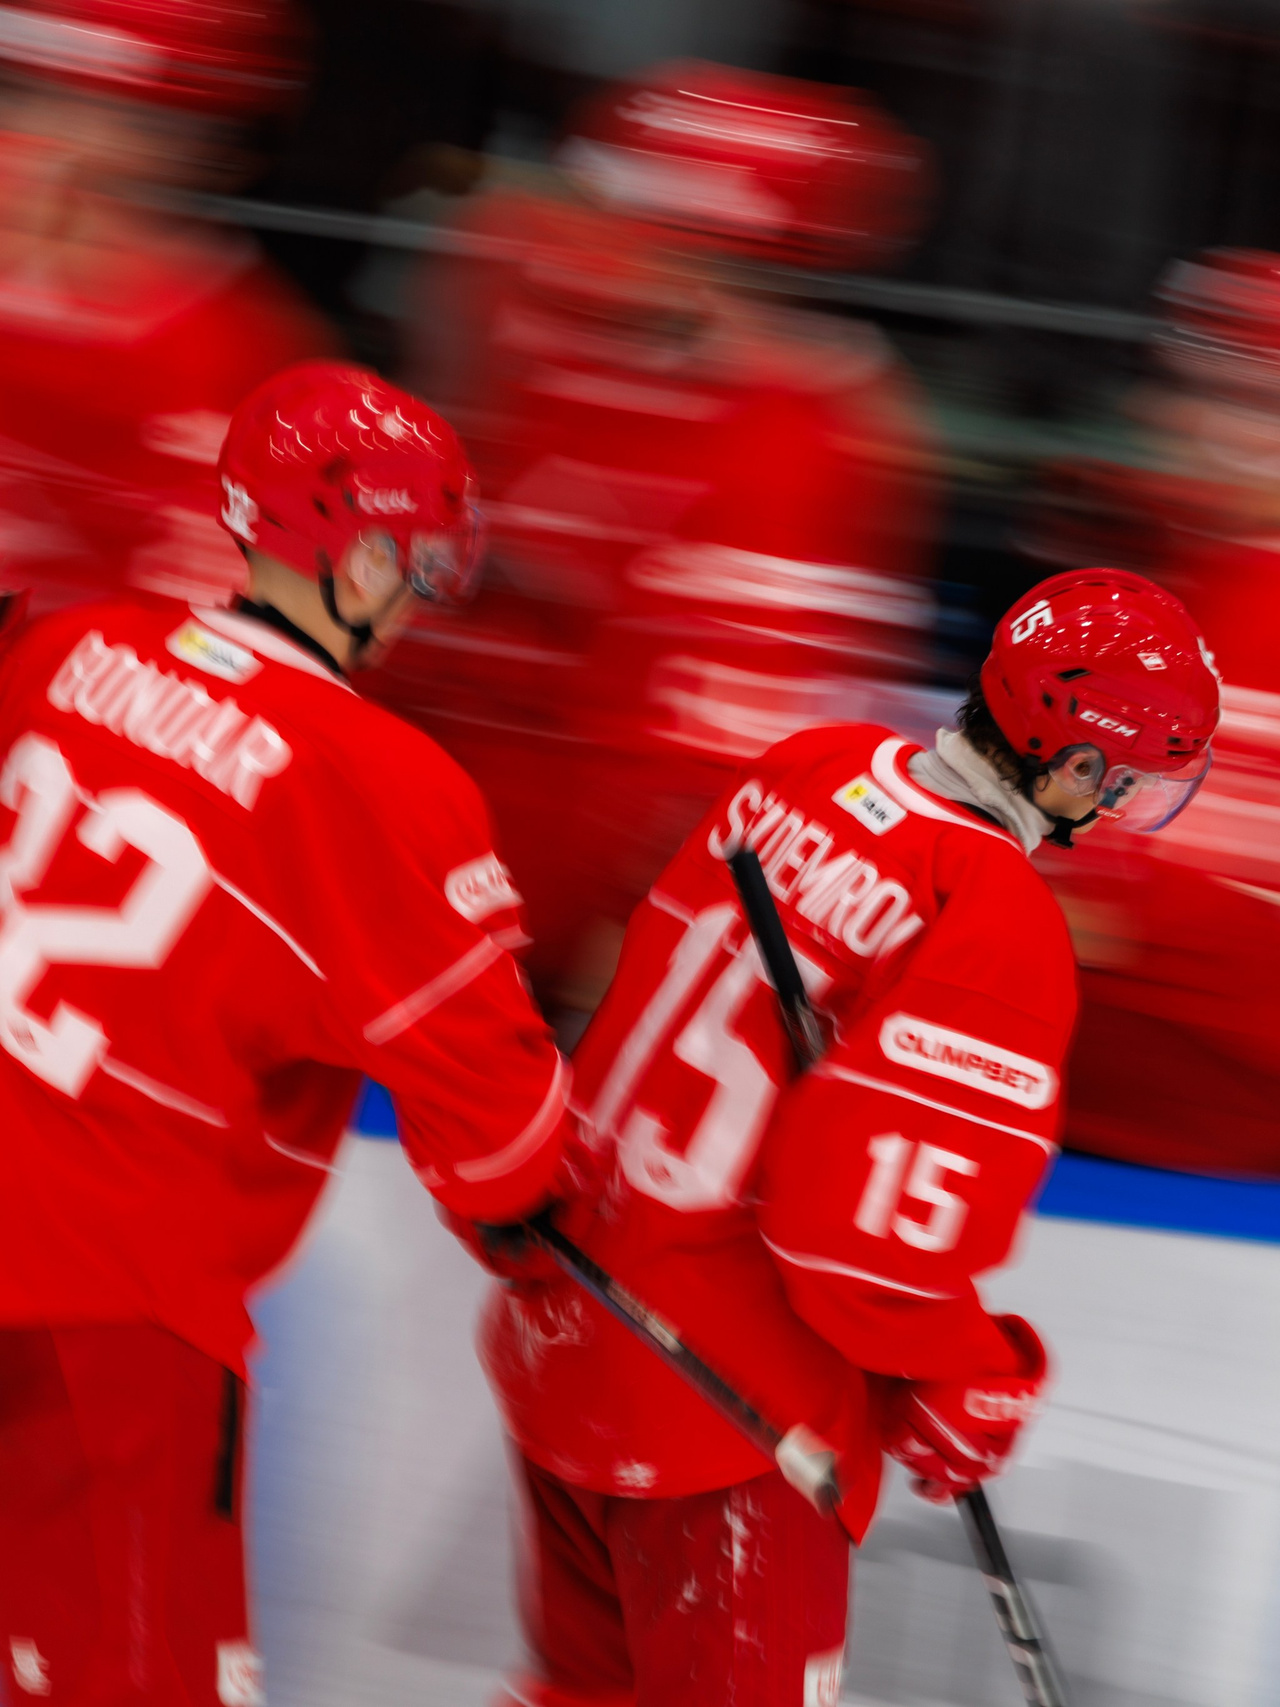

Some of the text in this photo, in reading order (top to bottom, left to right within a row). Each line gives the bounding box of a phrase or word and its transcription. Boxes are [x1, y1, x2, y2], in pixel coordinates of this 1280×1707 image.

[1010, 599, 1054, 645] 15
[1079, 709, 1138, 737] CCM
[583, 900, 835, 1214] 15
[853, 1131, 980, 1253] 15
